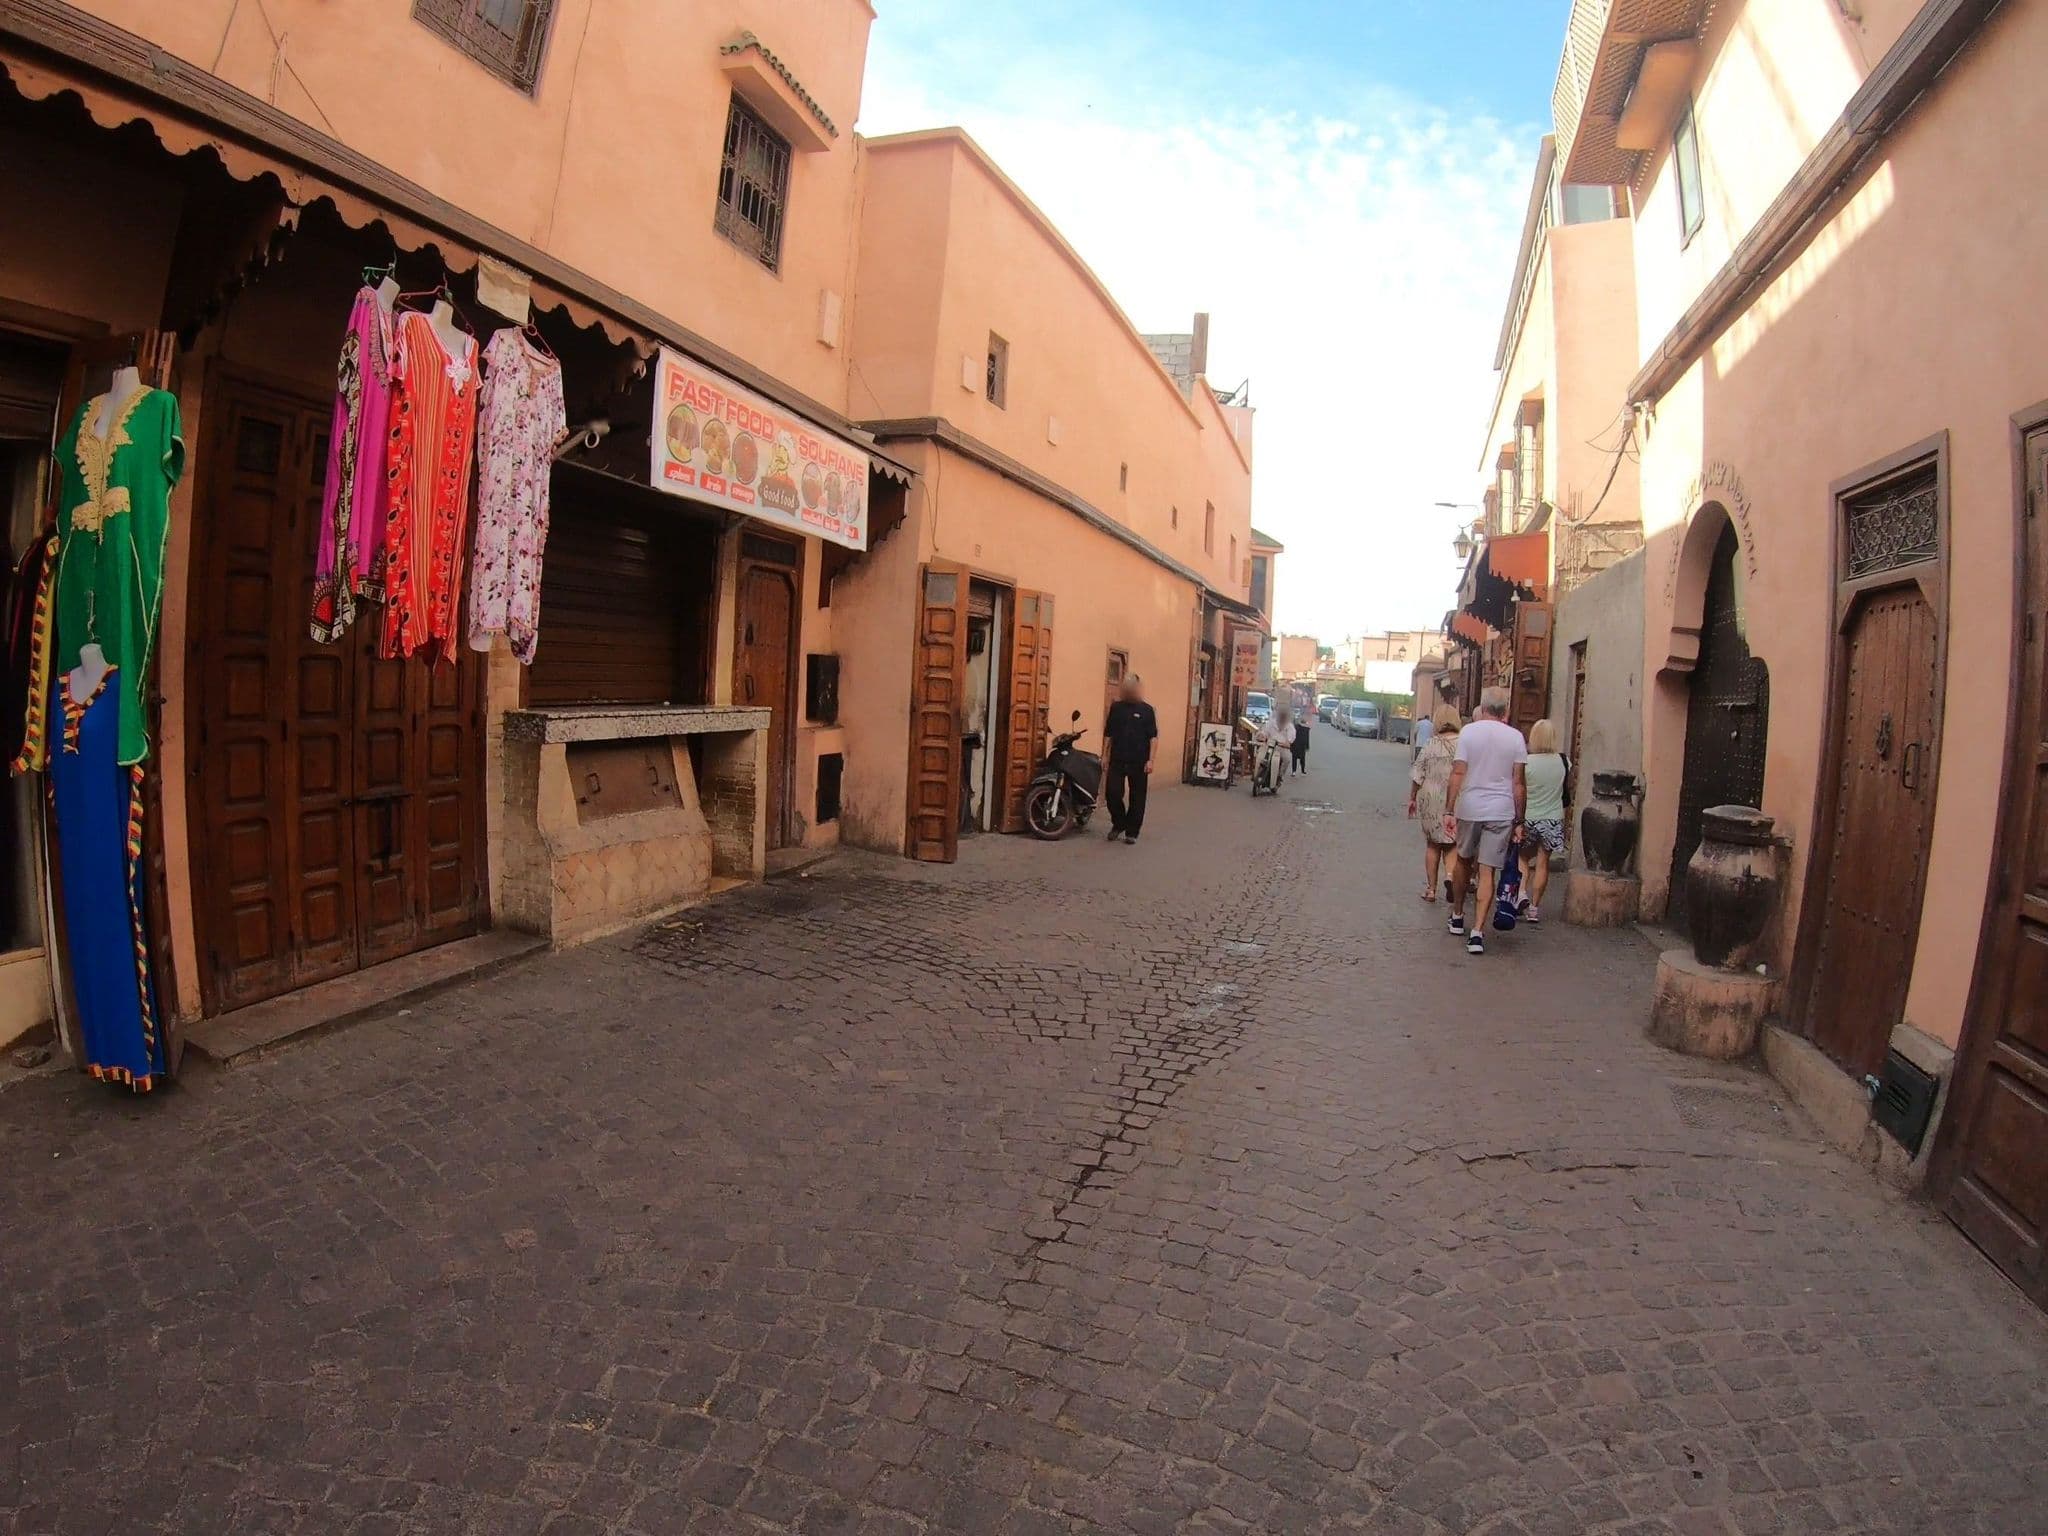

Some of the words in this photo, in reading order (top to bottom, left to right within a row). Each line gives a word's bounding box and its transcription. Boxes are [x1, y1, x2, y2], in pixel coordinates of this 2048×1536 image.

[669, 371, 725, 416] FAST
[726, 400, 775, 442] FOOD
[763, 485, 780, 503] Good
[781, 491, 796, 509] food
